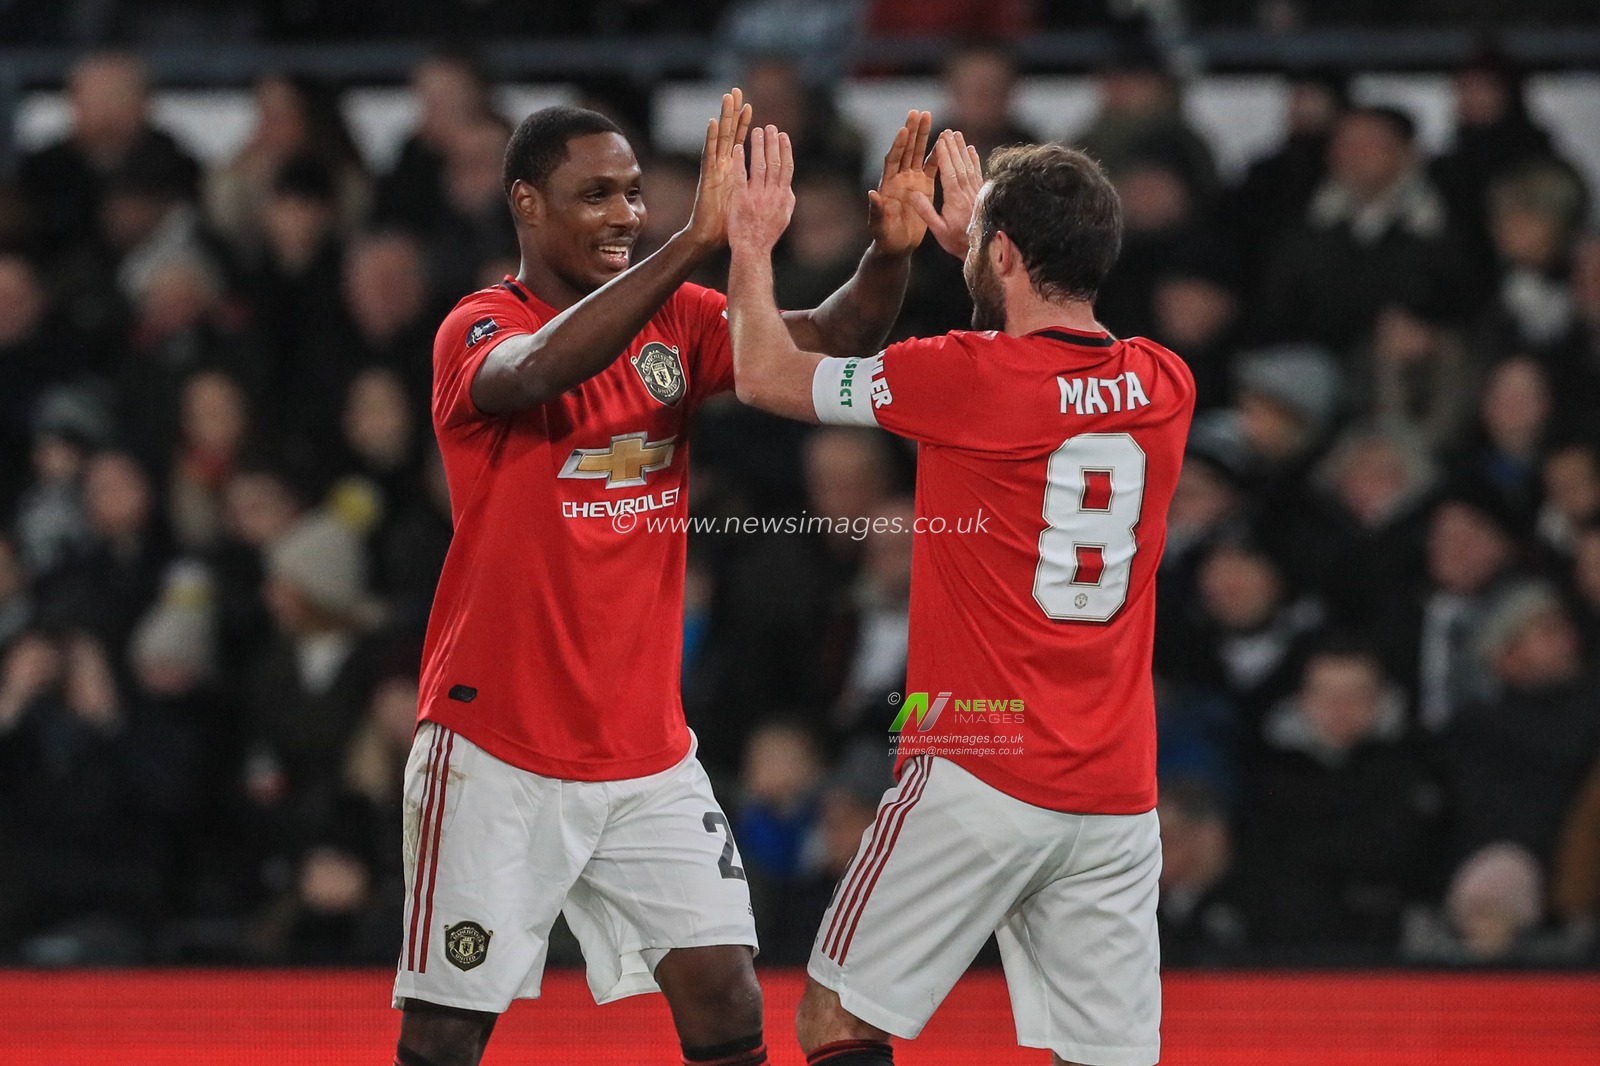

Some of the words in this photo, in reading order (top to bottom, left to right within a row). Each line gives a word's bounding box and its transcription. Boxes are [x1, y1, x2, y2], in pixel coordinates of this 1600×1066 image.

[1056, 371, 1151, 415] MATA
[562, 487, 680, 518] CHEVROLET
[1032, 432, 1147, 622] 8
